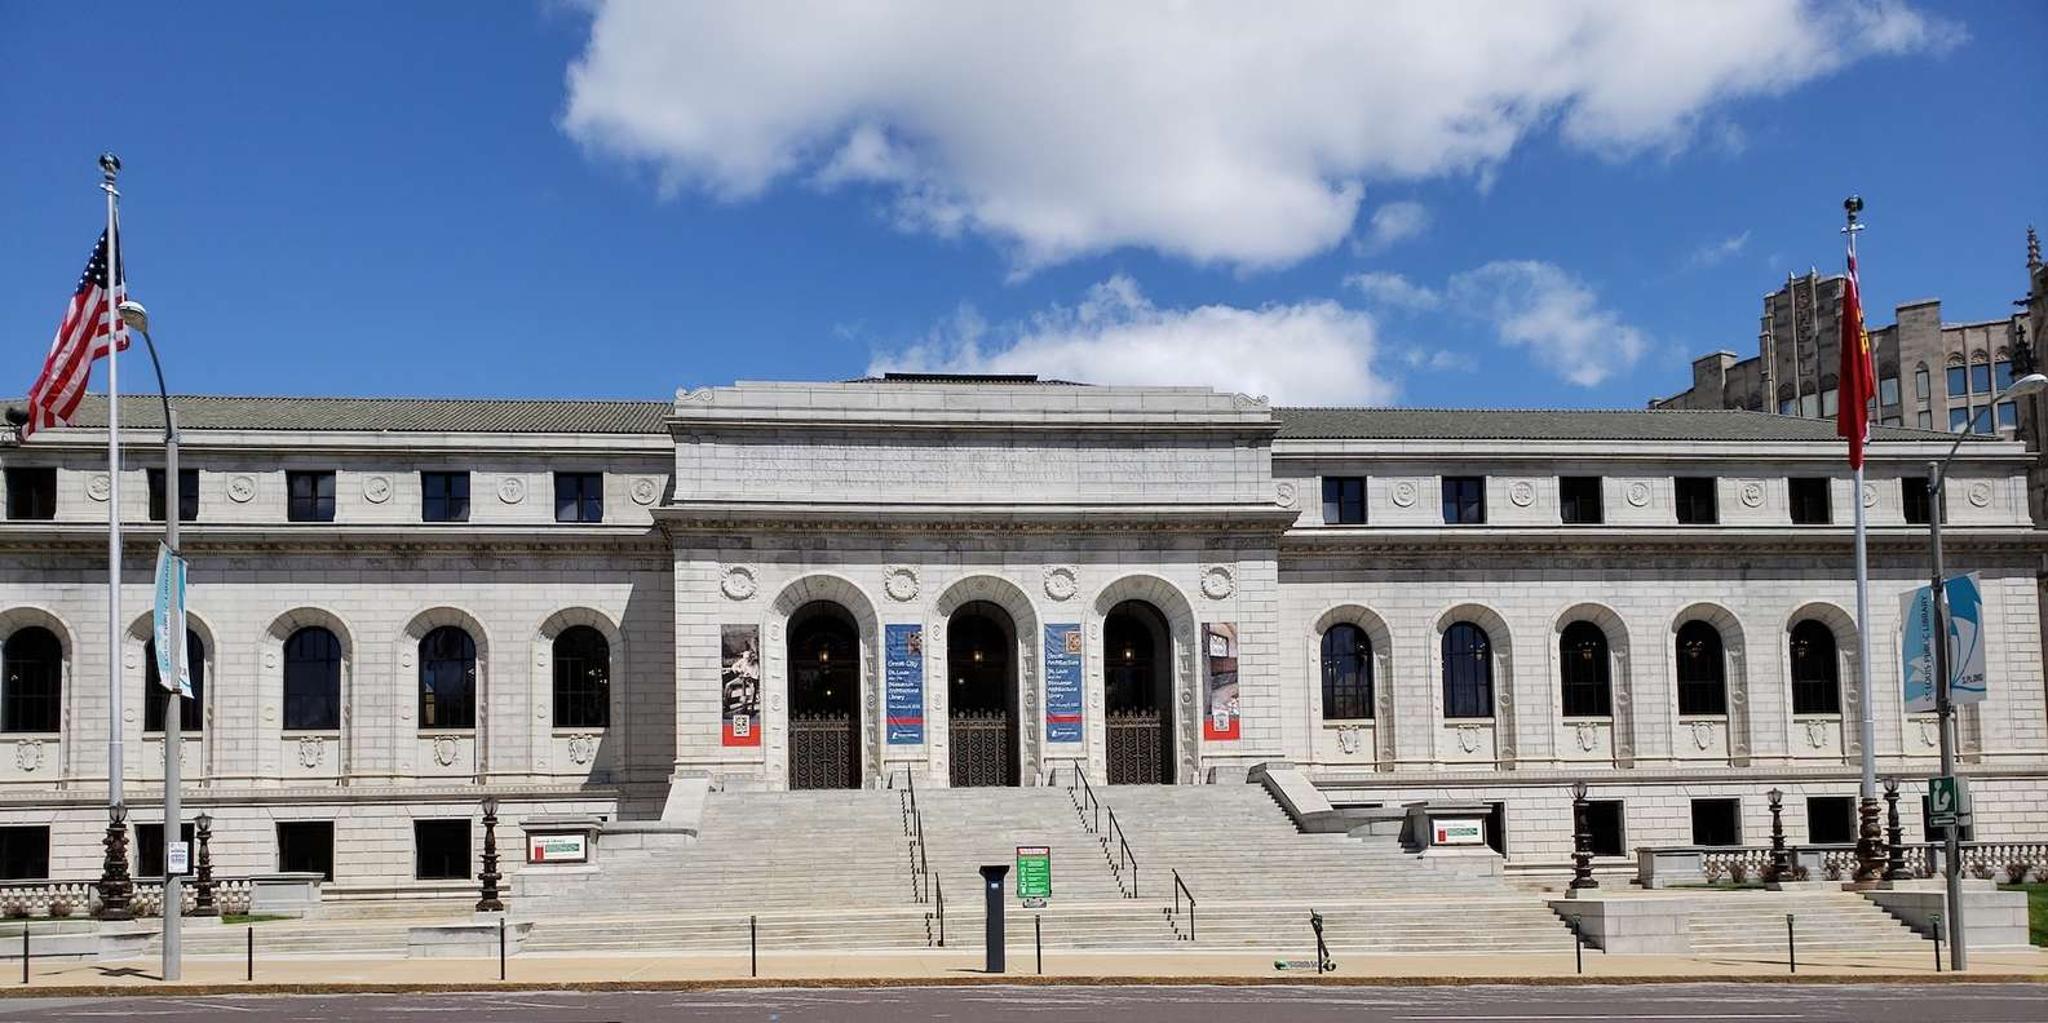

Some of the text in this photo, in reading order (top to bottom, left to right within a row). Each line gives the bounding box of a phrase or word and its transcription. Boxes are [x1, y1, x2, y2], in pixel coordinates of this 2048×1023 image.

[1920, 595, 1931, 631] LIBRARY
[1921, 632, 1932, 662] PUBLIC
[1922, 664, 1932, 689] LOUIS
